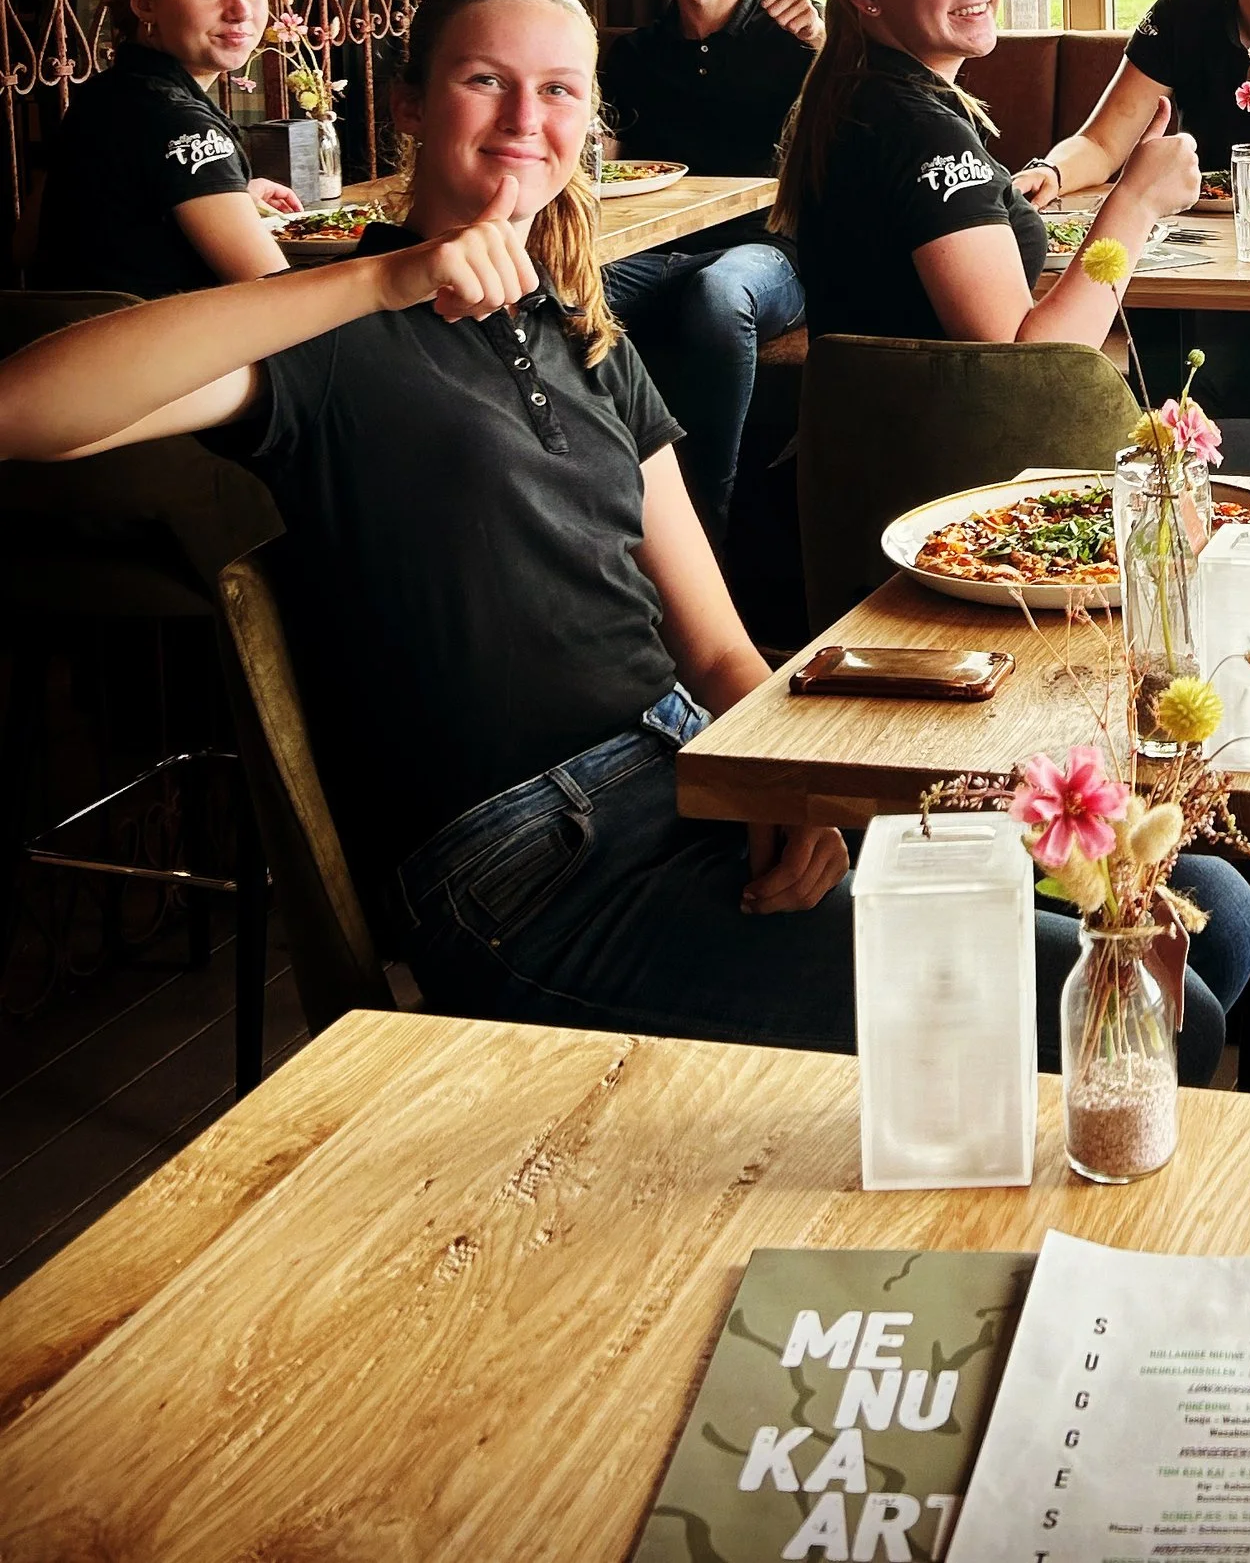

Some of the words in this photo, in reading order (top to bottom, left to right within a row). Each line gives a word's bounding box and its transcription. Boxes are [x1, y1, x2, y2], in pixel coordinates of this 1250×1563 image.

[780, 1310, 914, 1369] ME
[833, 1369, 959, 1431] NU
[738, 1426, 868, 1493] KA
